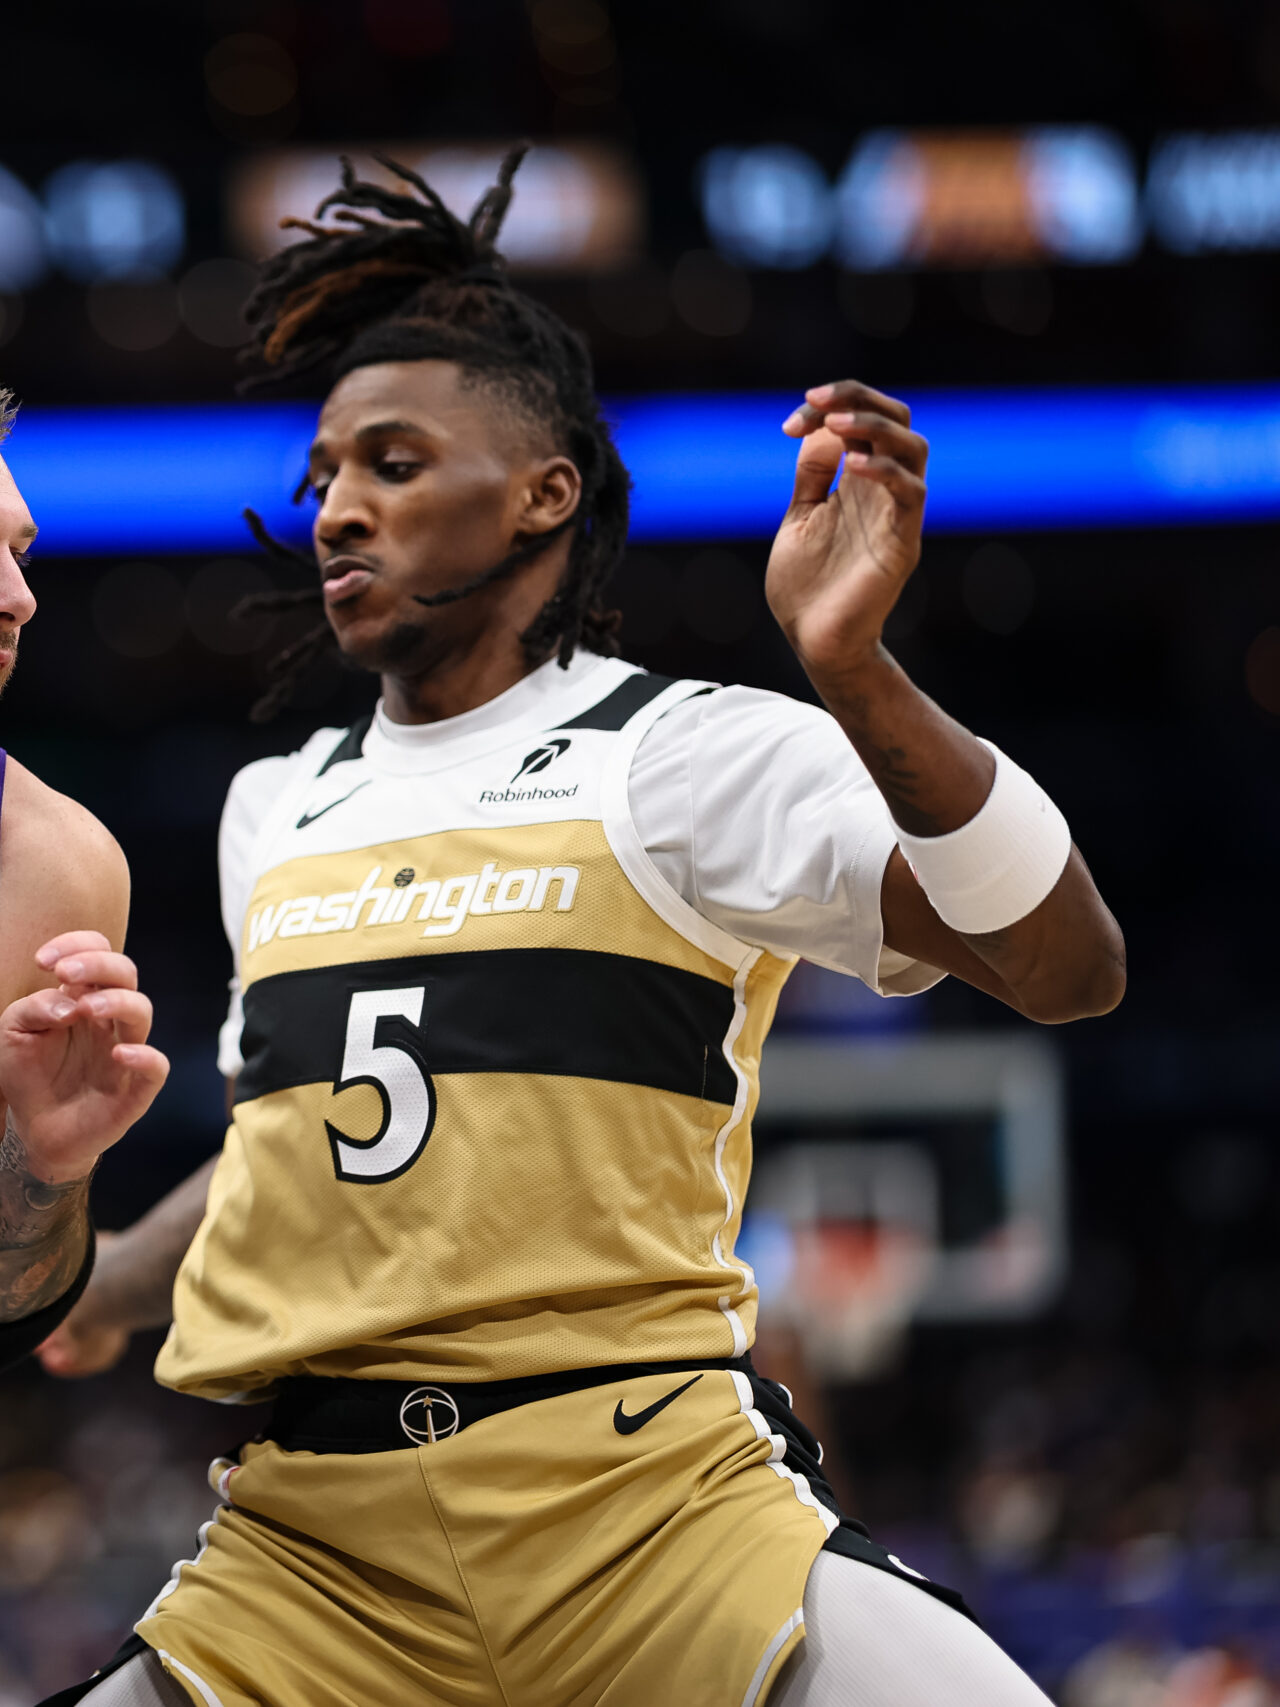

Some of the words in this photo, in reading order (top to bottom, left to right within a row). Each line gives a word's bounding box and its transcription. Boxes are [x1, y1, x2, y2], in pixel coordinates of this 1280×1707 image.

[478, 784, 579, 804] Robinhood
[247, 862, 583, 952] washington
[324, 981, 438, 1185] 5
